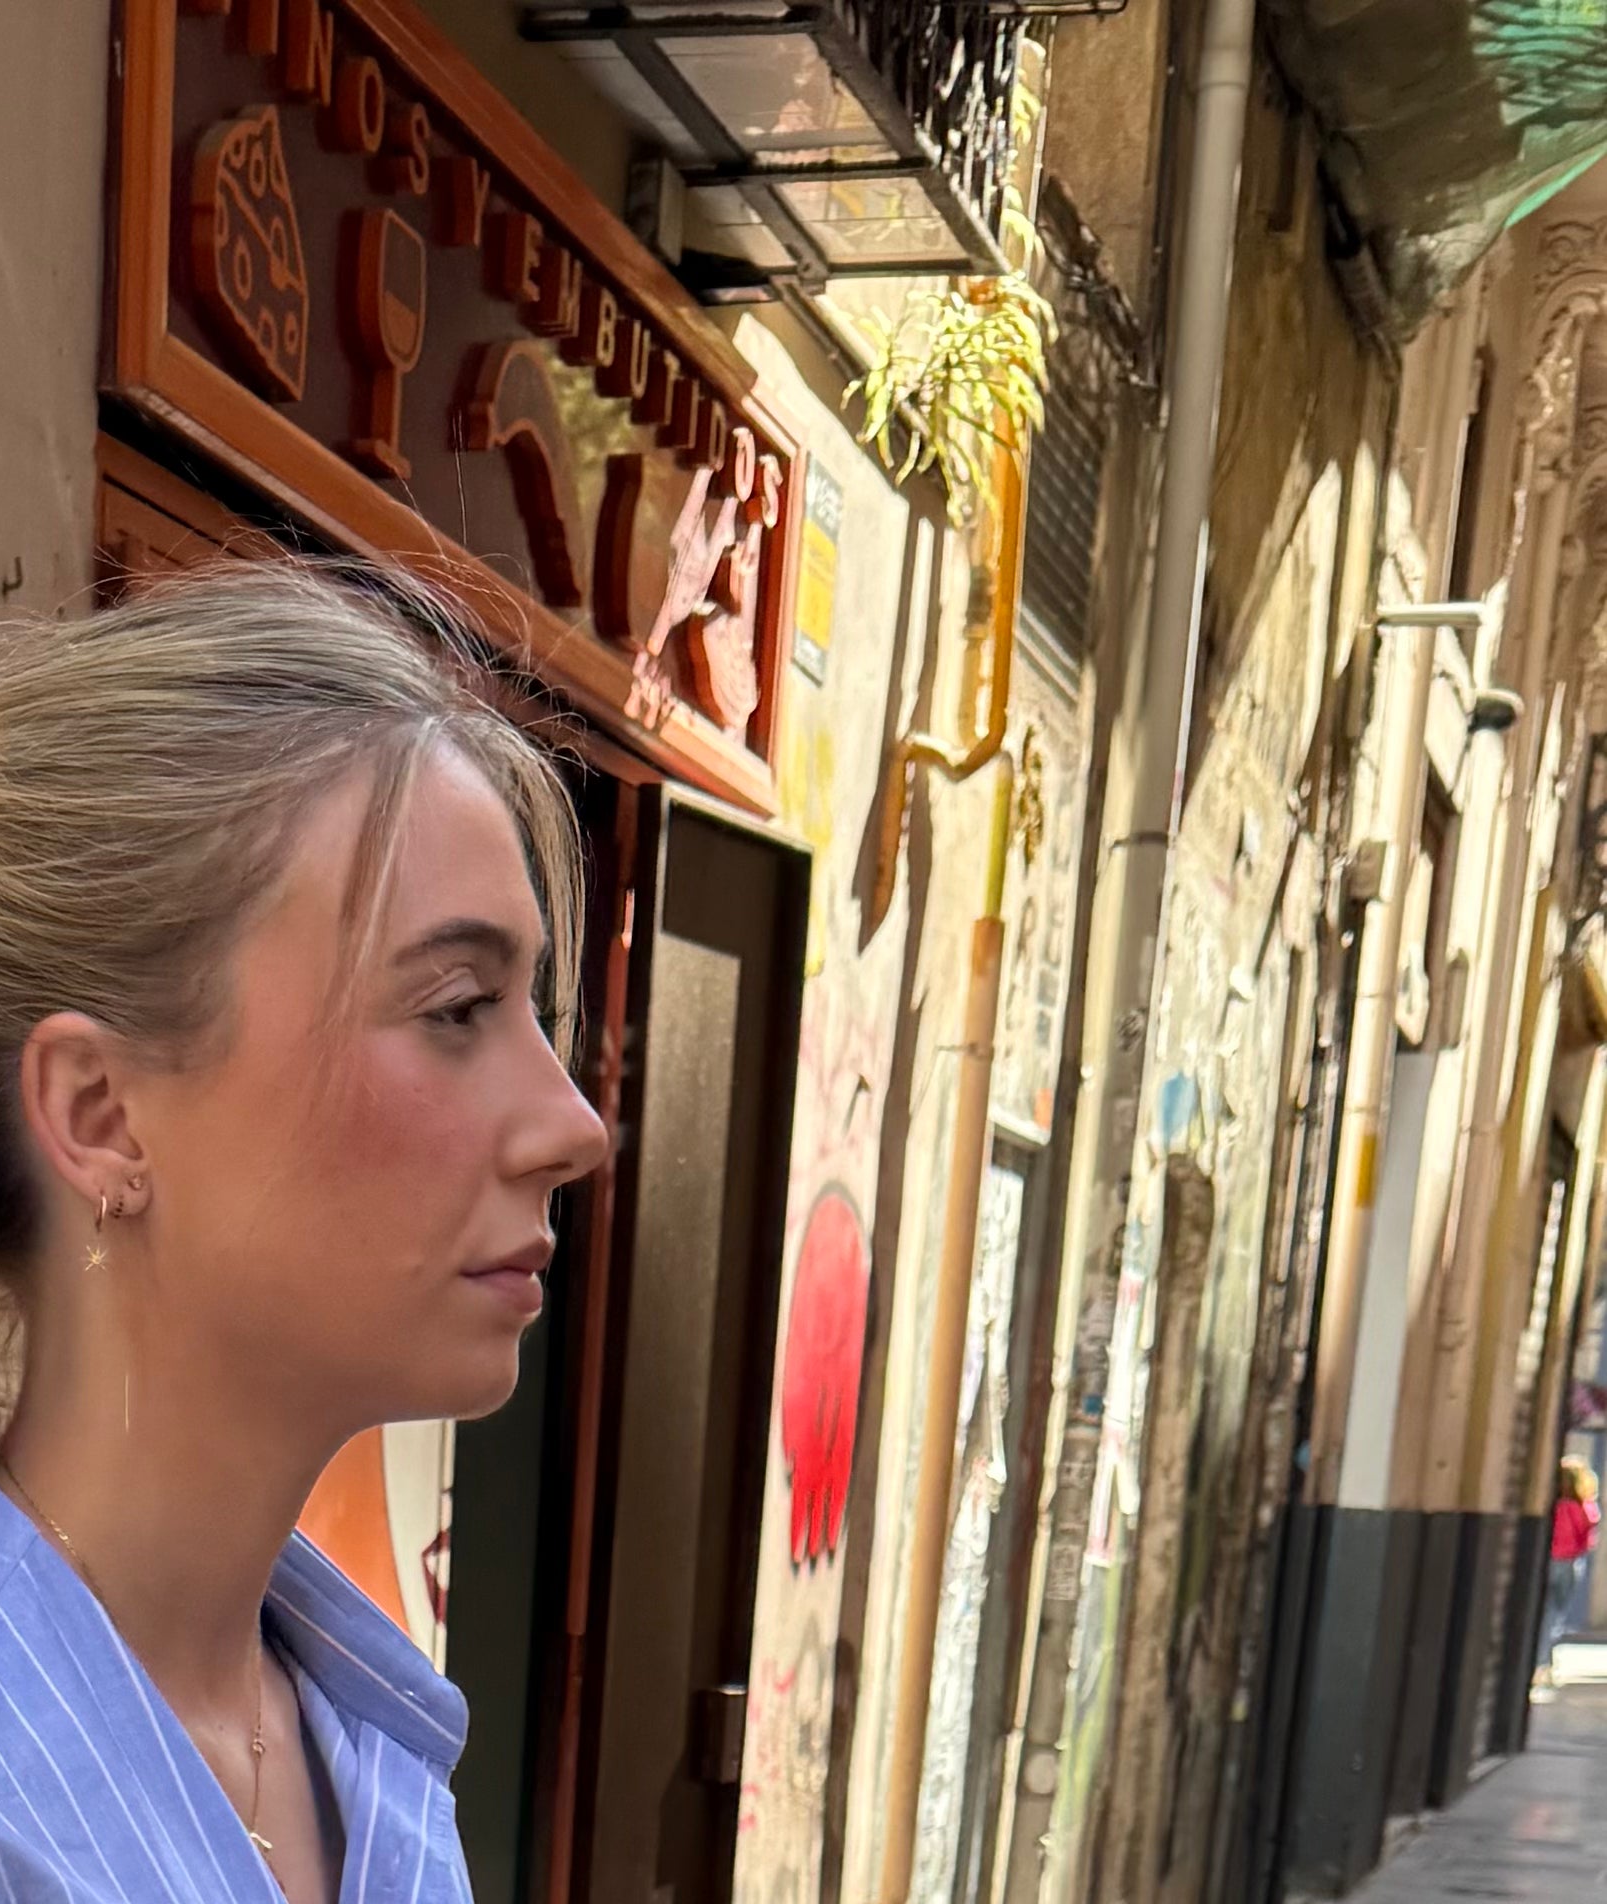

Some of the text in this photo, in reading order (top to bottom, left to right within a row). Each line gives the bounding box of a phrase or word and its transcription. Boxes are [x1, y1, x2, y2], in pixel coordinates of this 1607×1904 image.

[209, 0, 431, 197] INOS
[456, 155, 491, 248] Y
[512, 212, 784, 529] EMBUTIDOS
